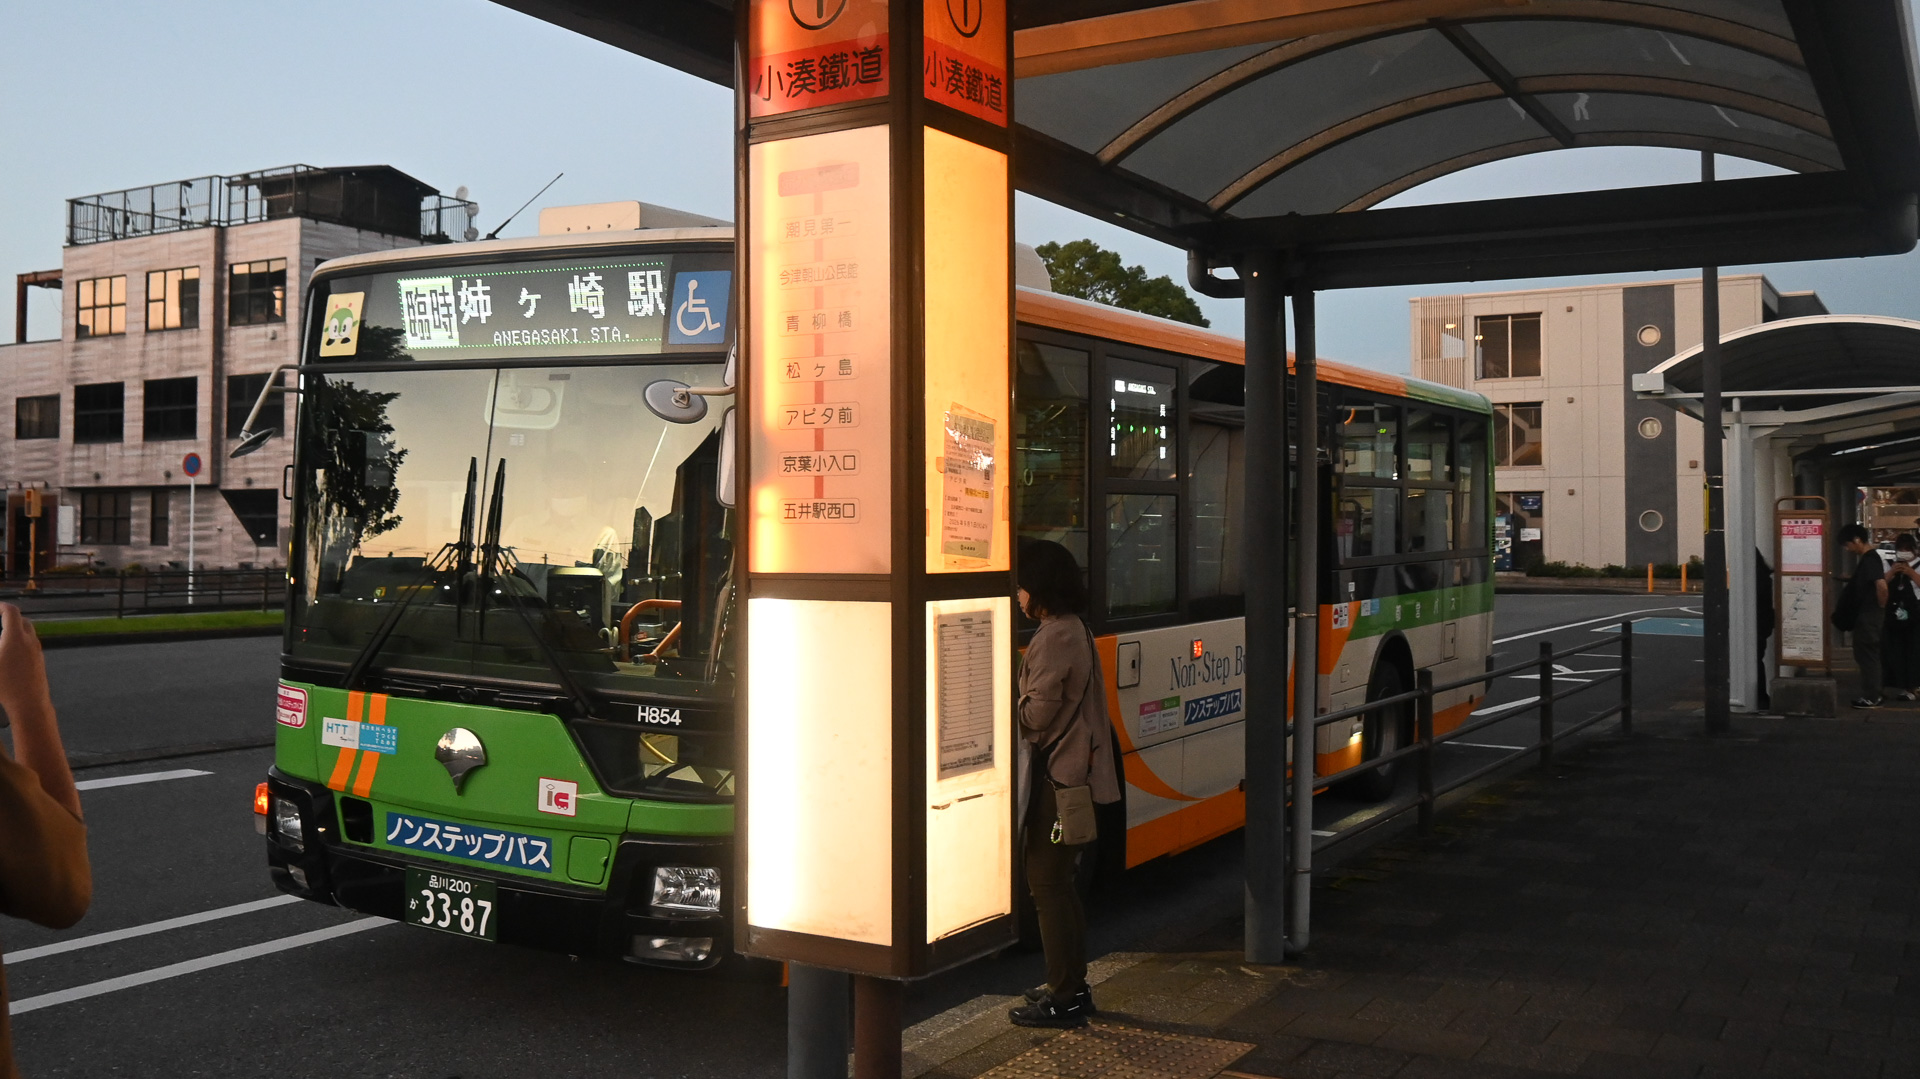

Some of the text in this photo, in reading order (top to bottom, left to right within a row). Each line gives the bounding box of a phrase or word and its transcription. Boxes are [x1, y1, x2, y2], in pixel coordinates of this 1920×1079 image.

[755, 44, 883, 101] 小湊鐵道
[925, 50, 1003, 113] 小湊鐵道
[786, 217, 851, 238] 潮見第一
[779, 263, 859, 286] 今津朝山公民館
[404, 283, 456, 340] 臨時
[785, 311, 852, 332] 青柳橋
[493, 327, 631, 347] ANEGASAKI STA.
[786, 407, 853, 425] アピタ前
[782, 455, 856, 473] 京葉小入口
[783, 503, 856, 520] 五井駅西口
[637, 705, 682, 726] H854
[1185, 691, 1241, 722] ノンステップバス
[326, 722, 349, 735] HTT
[386, 817, 551, 869] ノンステップバス
[428, 875, 471, 894] 品川200
[409, 898, 419, 910] か
